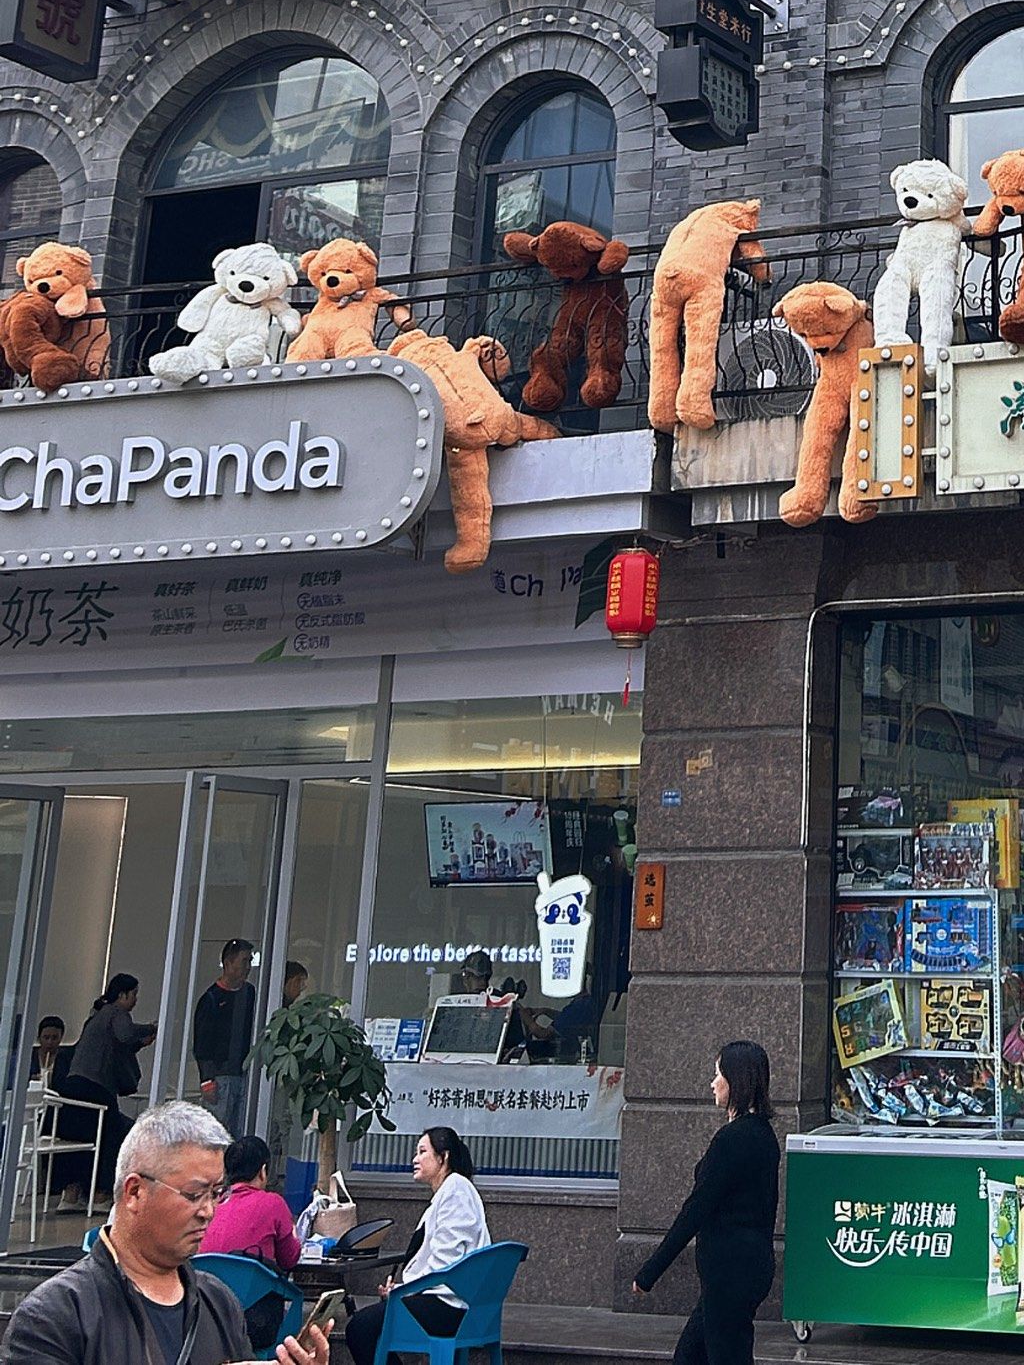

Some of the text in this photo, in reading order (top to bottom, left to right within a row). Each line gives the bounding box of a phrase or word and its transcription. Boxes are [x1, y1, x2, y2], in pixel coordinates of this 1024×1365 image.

[0, 420, 346, 514] ChaPanda
[300, 569, 342, 588] 真纯净
[0, 581, 119, 649] 奶茶
[345, 943, 409, 965] Eplore
[413, 943, 441, 962] the
[854, 1201, 957, 1228] 蒙牛 冰淇淋
[832, 1226, 953, 1258] 快乐传中国
